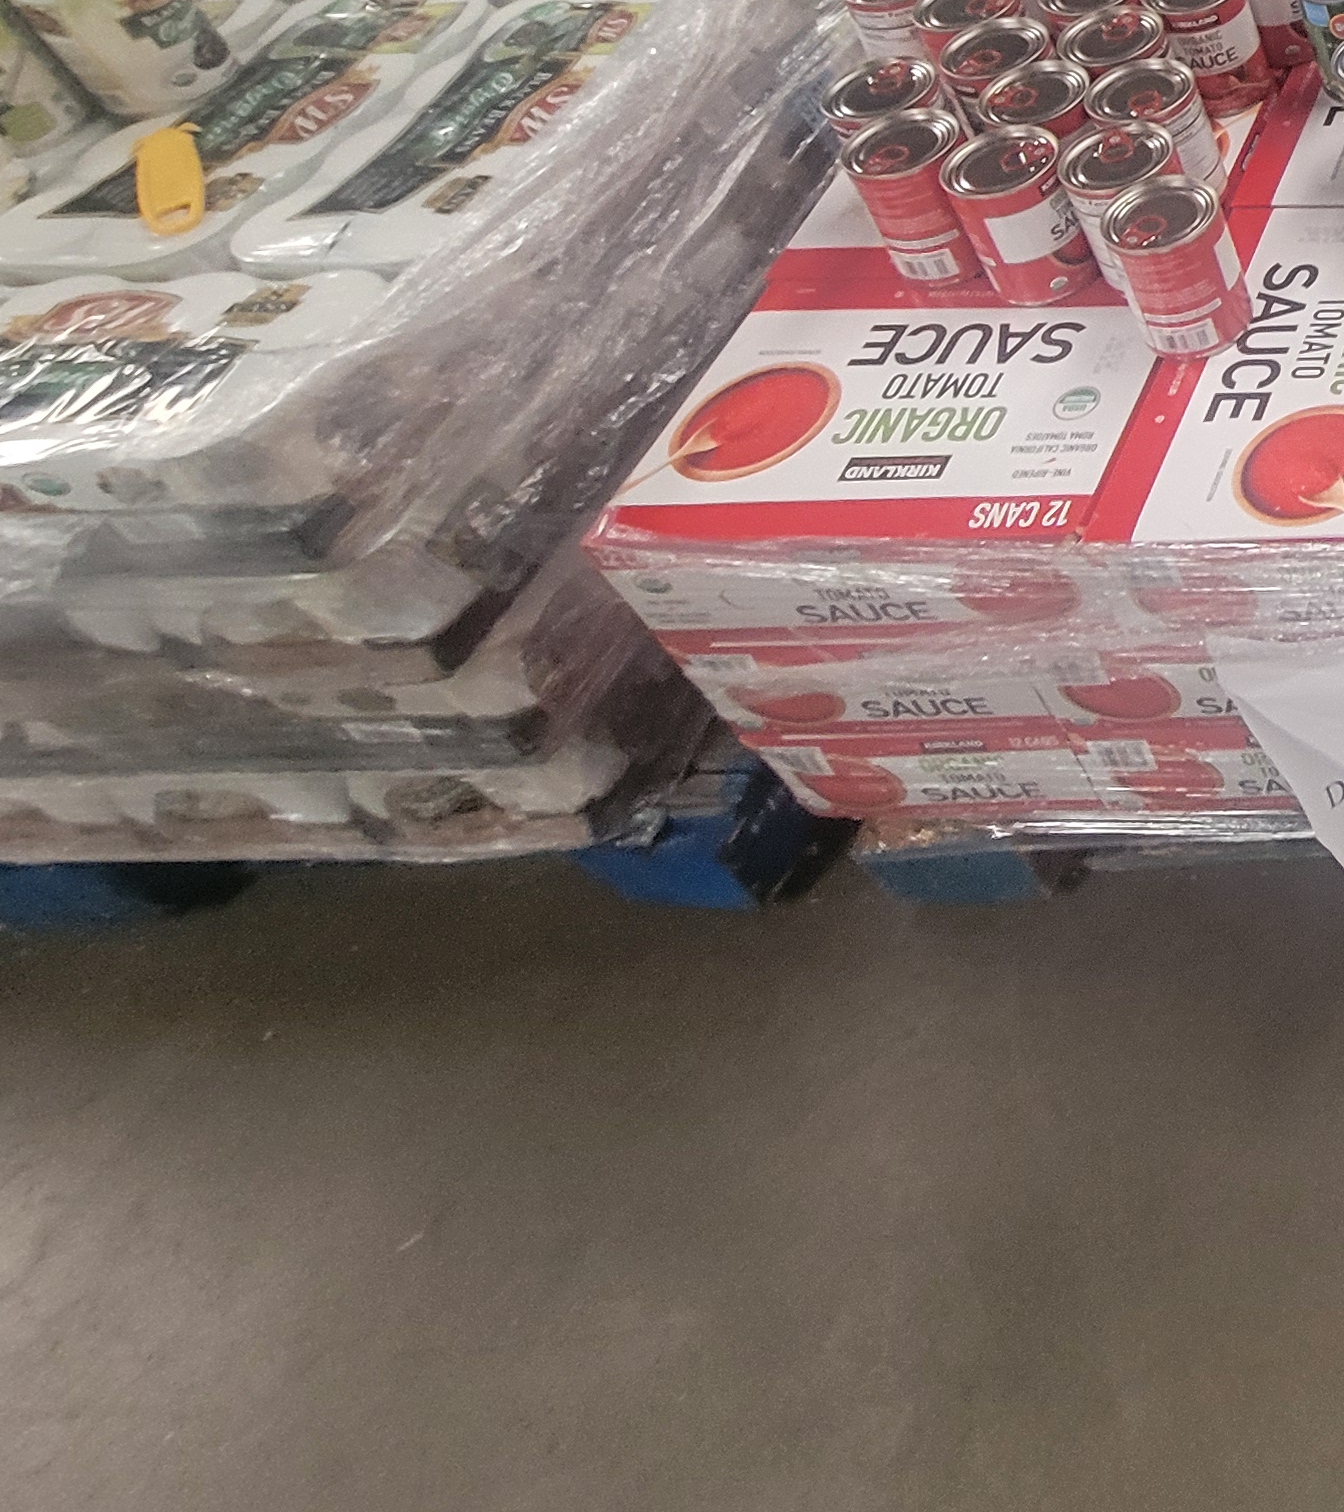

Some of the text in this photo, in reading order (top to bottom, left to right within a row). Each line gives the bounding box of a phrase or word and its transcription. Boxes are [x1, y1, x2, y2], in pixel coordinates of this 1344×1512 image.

[847, 321, 1087, 367] SAUCE
[1202, 262, 1320, 423] SAUCE
[880, 372, 1004, 400] TOMATO
[831, 405, 1008, 446] ORGANIC
[844, 462, 943, 481] KIRKLAND
[968, 499, 1072, 529] 12 CANS
[794, 602, 942, 624] SAUCE
[860, 697, 996, 719] SAUCE
[919, 781, 1042, 802] SAUCE
